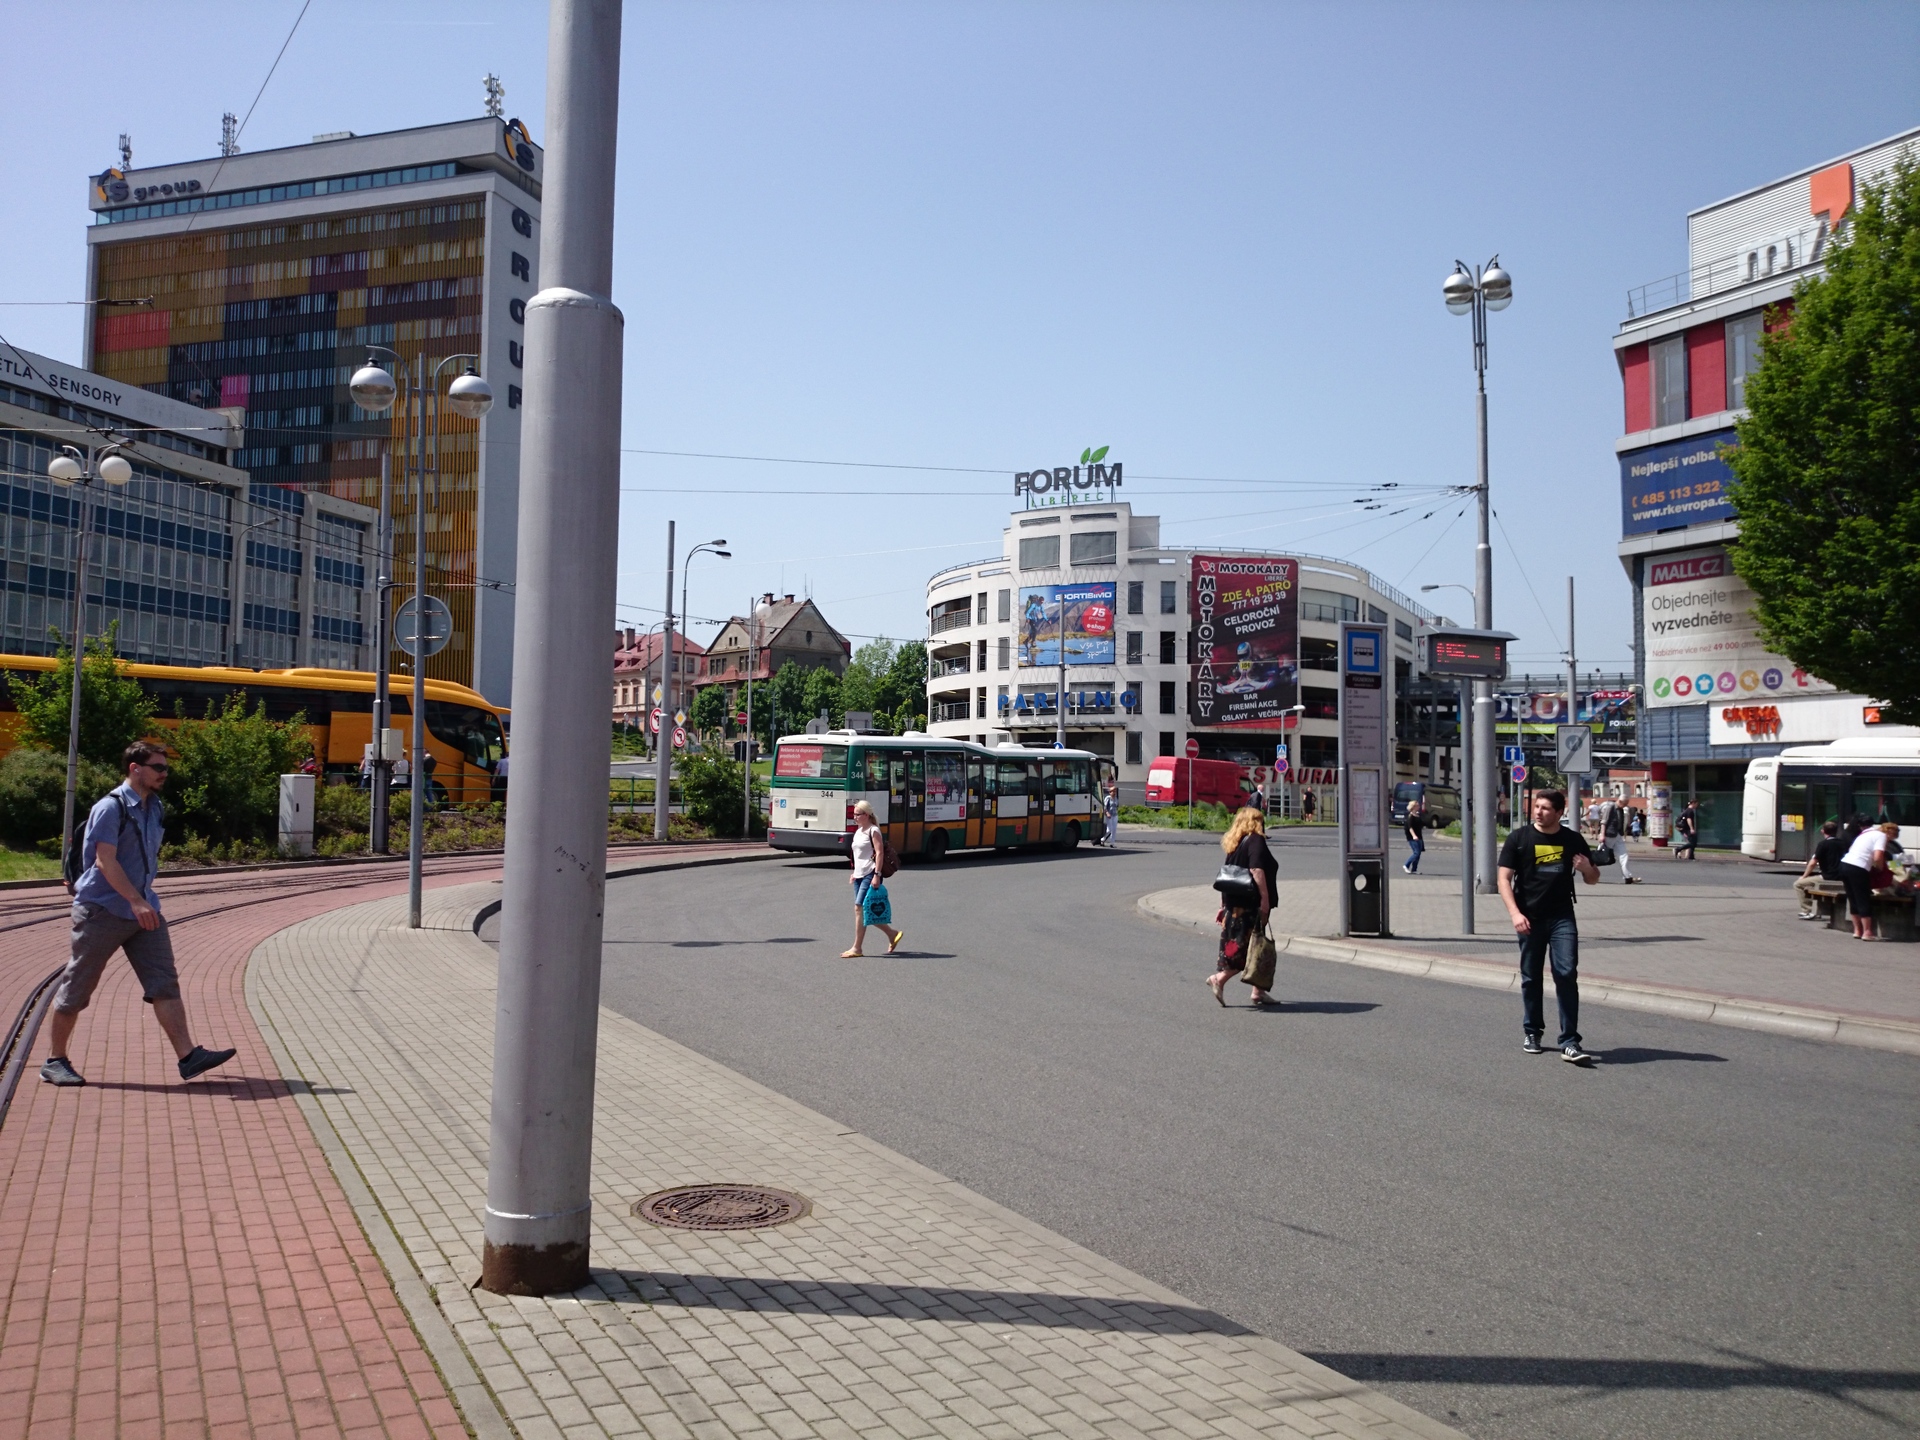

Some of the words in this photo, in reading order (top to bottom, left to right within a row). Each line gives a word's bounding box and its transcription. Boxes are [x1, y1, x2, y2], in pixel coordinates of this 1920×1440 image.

[134, 179, 201, 201] group
[49, 373, 122, 406] SENSORY
[1631, 456, 1679, 478] Nejlepší
[1681, 450, 1716, 466] volba
[1014, 462, 1123, 497] FORUM
[1031, 491, 1104, 508] LIBEREC
[1641, 490, 1666, 506] 485
[1669, 486, 1691, 500] 113
[1694, 480, 1721, 496] 322
[1219, 561, 1290, 576] MOTOKÁRY
[1653, 558, 1720, 583] MALL.CZ
[1221, 589, 1243, 604] ZDE
[1245, 588, 1254, 598] 4.
[1256, 580, 1292, 597] PATRO
[1232, 600, 1248, 611] 777
[1250, 596, 1261, 607] 19
[1262, 594, 1274, 604] 29
[1275, 590, 1287, 600] 39
[1651, 589, 1727, 612] Objednejte
[1091, 606, 1106, 618] 75
[1223, 604, 1281, 627] CELOROČNÍ
[1651, 610, 1733, 635] vyzvedněte
[1235, 618, 1276, 636] PROVOZ
[1197, 575, 1217, 718] MOTOKÁRY
[1685, 644, 1698, 654] více
[1713, 642, 1723, 651] 49
[1725, 641, 1740, 650] 000
[997, 690, 1137, 711] PARKING
[1229, 701, 1257, 711] FIREMNÍ
[1258, 700, 1278, 709] AKCE
[1222, 714, 1249, 722] OSLAVY
[1722, 705, 1780, 723] CINEMA
[1746, 717, 1781, 735] CITY
[832, 765, 843, 776] 15
[851, 771, 864, 779] 344
[820, 790, 834, 798] 344
